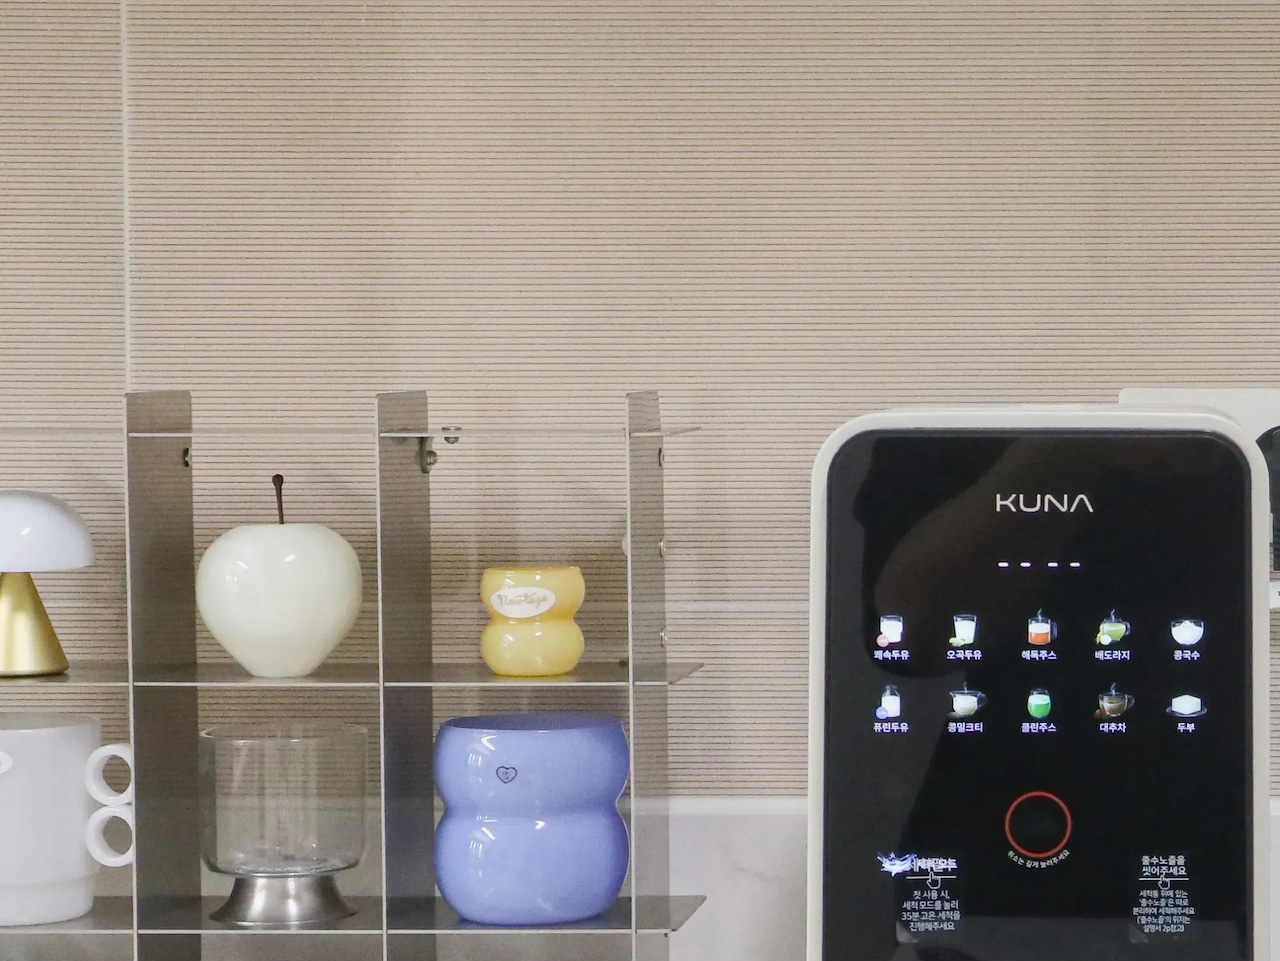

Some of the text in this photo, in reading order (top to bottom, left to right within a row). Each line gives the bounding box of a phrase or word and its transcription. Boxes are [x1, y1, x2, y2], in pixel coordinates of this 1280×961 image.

[873, 649, 910, 661] 쾌속두유
[946, 649, 983, 661] 오곡두유
[1021, 649, 1057, 661] 해독주스
[1094, 649, 1131, 661] 배도라지
[1173, 649, 1201, 661] 콩국수
[947, 722, 983, 733] 콩밀크티
[1021, 722, 1057, 733] 클린주스
[1099, 722, 1127, 733] 대추차
[1176, 722, 1196, 733] 두부
[1007, 850, 1025, 865] 취소는
[1040, 849, 1070, 868] 눌러주세요
[1142, 855, 1186, 866] 출수노즐을
[1142, 866, 1187, 876] 씻어주세요
[912, 890, 921, 899] 첫
[922, 890, 938, 900] 사용
[1175, 890, 1189, 898] 있는
[902, 900, 959, 911] 세척 모드를 눌러
[901, 911, 961, 921] 35분 고온 세척을
[909, 922, 955, 932] 진행해주세요
